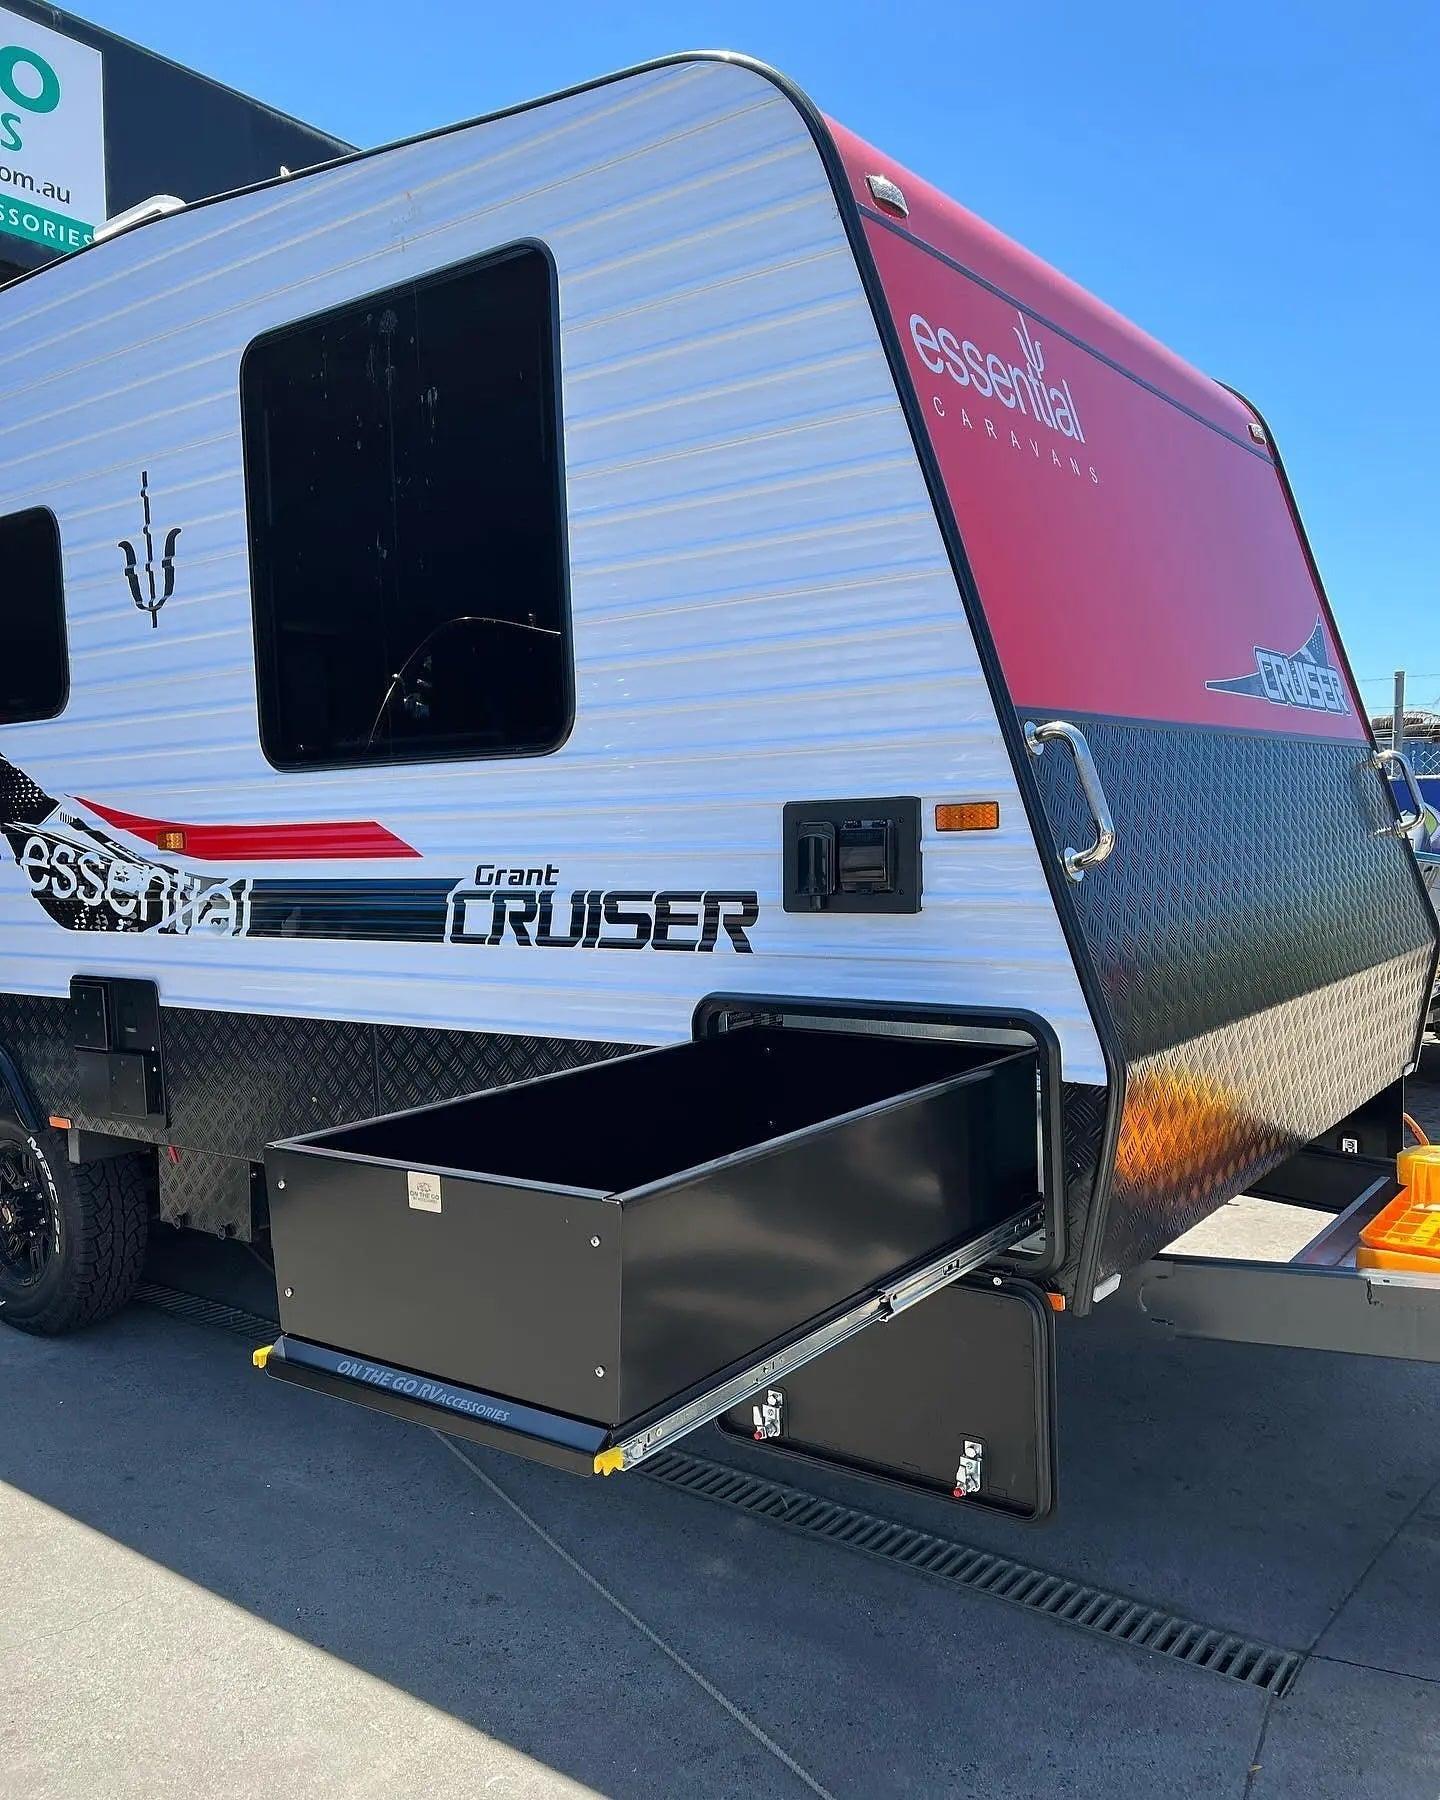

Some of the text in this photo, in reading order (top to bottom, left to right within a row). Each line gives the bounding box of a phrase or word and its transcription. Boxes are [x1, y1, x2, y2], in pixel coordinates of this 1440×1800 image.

[0, 46, 60, 113] O
[0, 112, 23, 152] S
[0, 166, 71, 204] om.au
[909, 311, 1086, 444] essential
[932, 396, 1098, 484] CARAVANS
[1255, 648, 1350, 716] CRUISER
[20, 835, 253, 937] essential
[474, 863, 560, 886] Grant
[448, 889, 759, 954] CRUISER
[336, 1360, 363, 1377] ON
[362, 1366, 394, 1387] THE
[391, 1376, 419, 1394] GO
